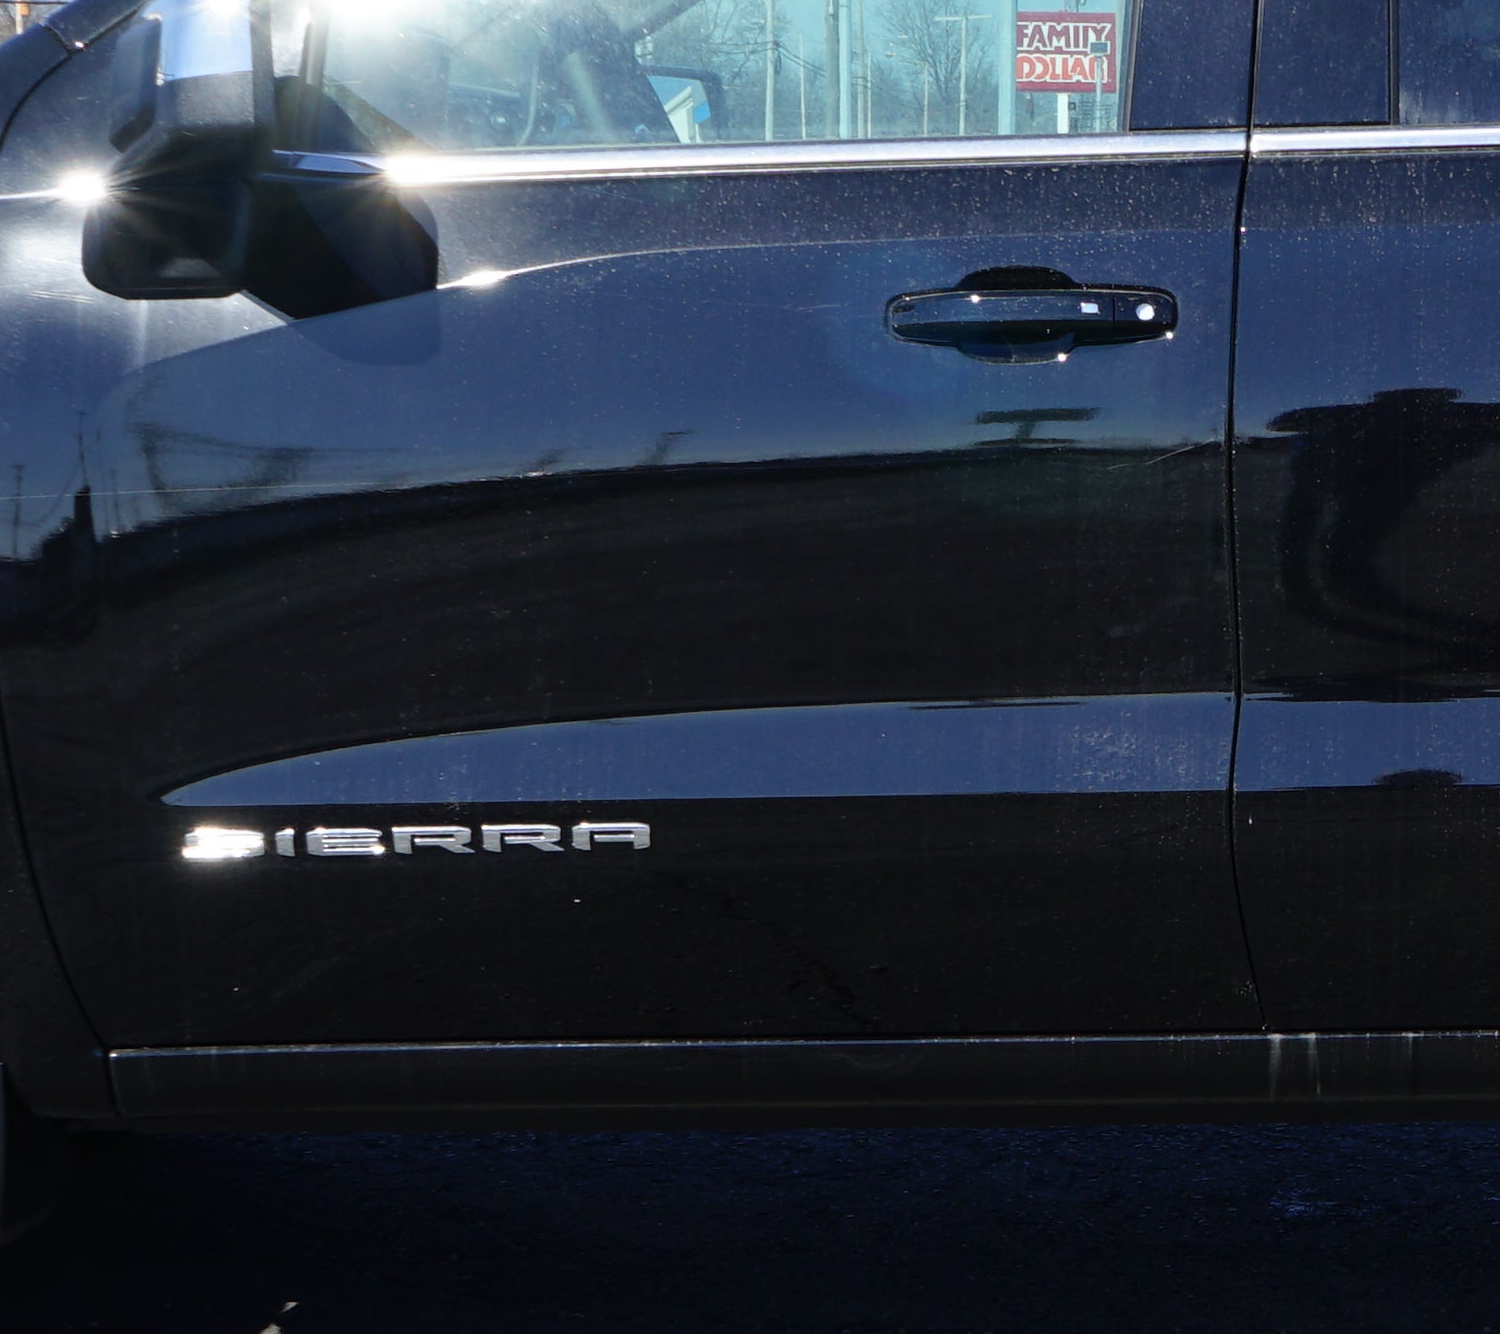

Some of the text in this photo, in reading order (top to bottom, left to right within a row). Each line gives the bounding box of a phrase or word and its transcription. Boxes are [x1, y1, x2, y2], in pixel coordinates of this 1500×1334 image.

[1017, 22, 1112, 52] FAMILY
[1016, 54, 1108, 84] DOLLAR
[182, 823, 651, 861] SIERRA
